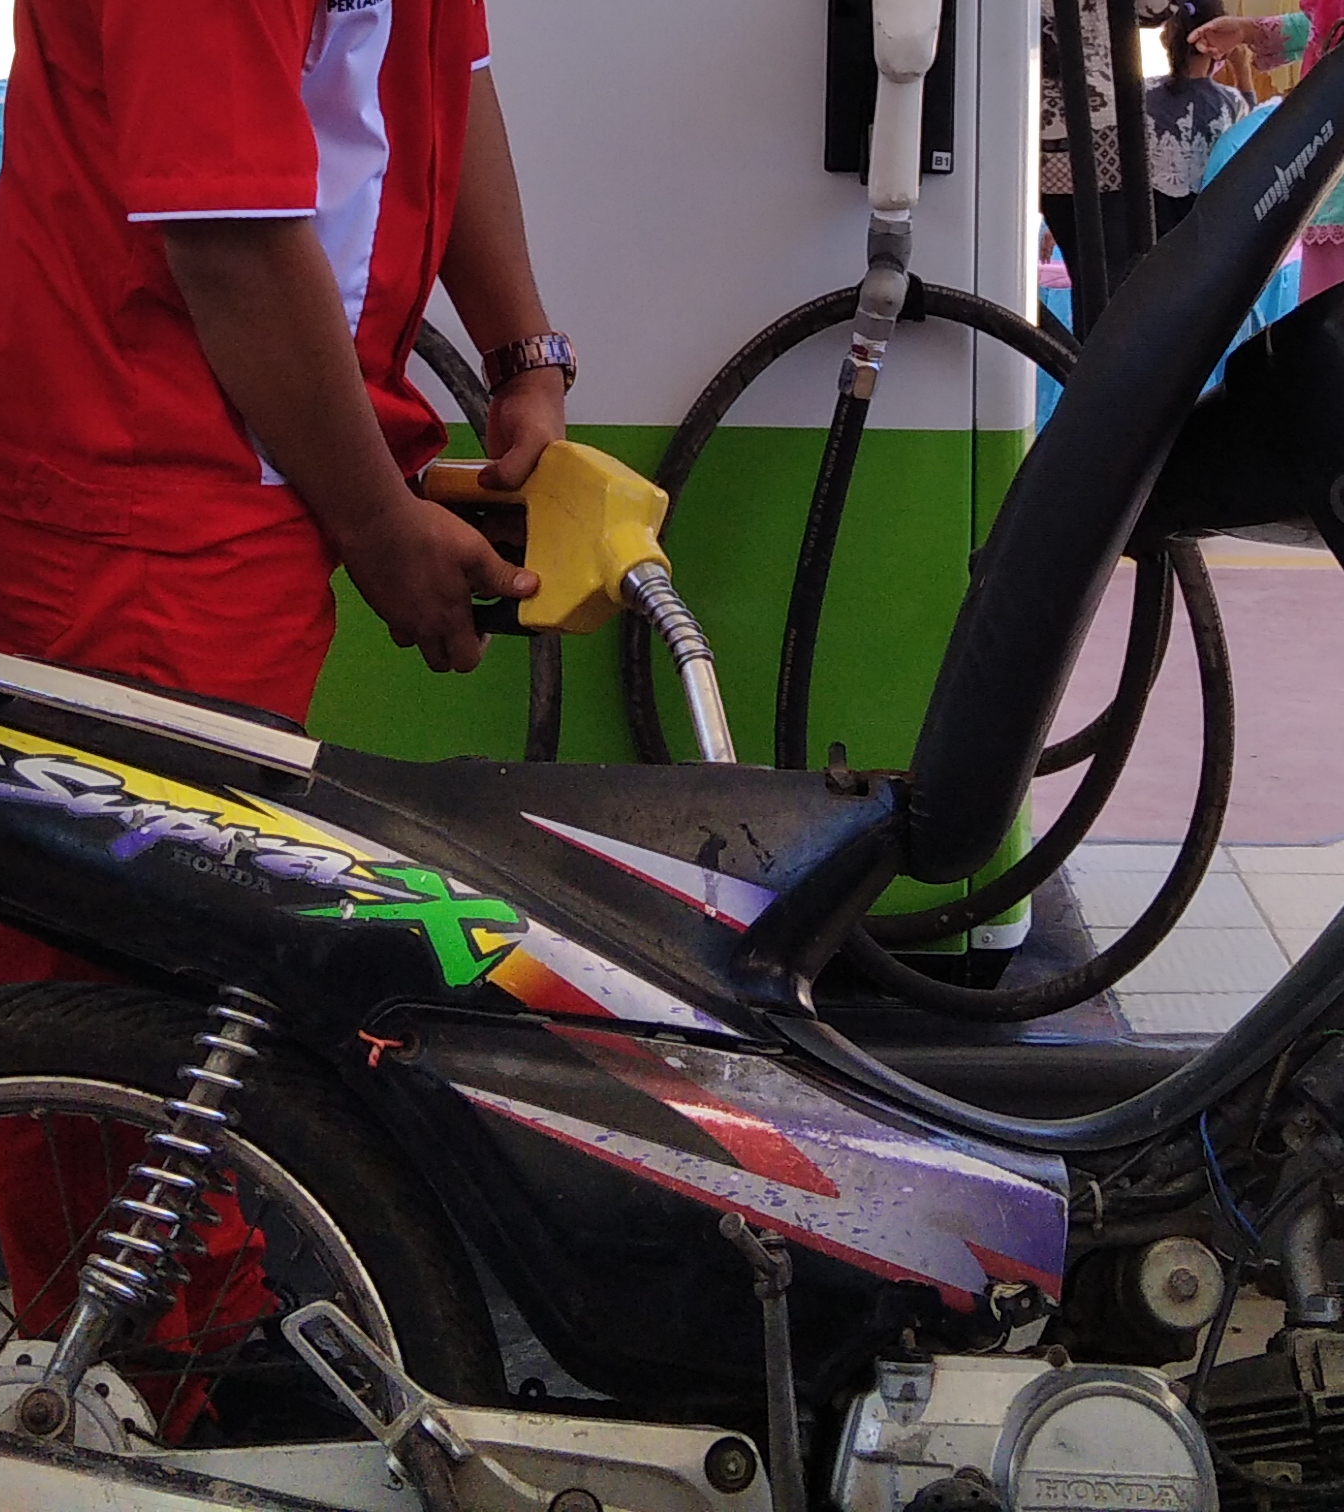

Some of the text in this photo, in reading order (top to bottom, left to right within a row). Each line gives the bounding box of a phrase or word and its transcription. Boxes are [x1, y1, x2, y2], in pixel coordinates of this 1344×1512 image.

[935, 155, 949, 167] B1
[1253, 119, 1334, 221] evolution
[1035, 1478, 1187, 1508] HONDA
